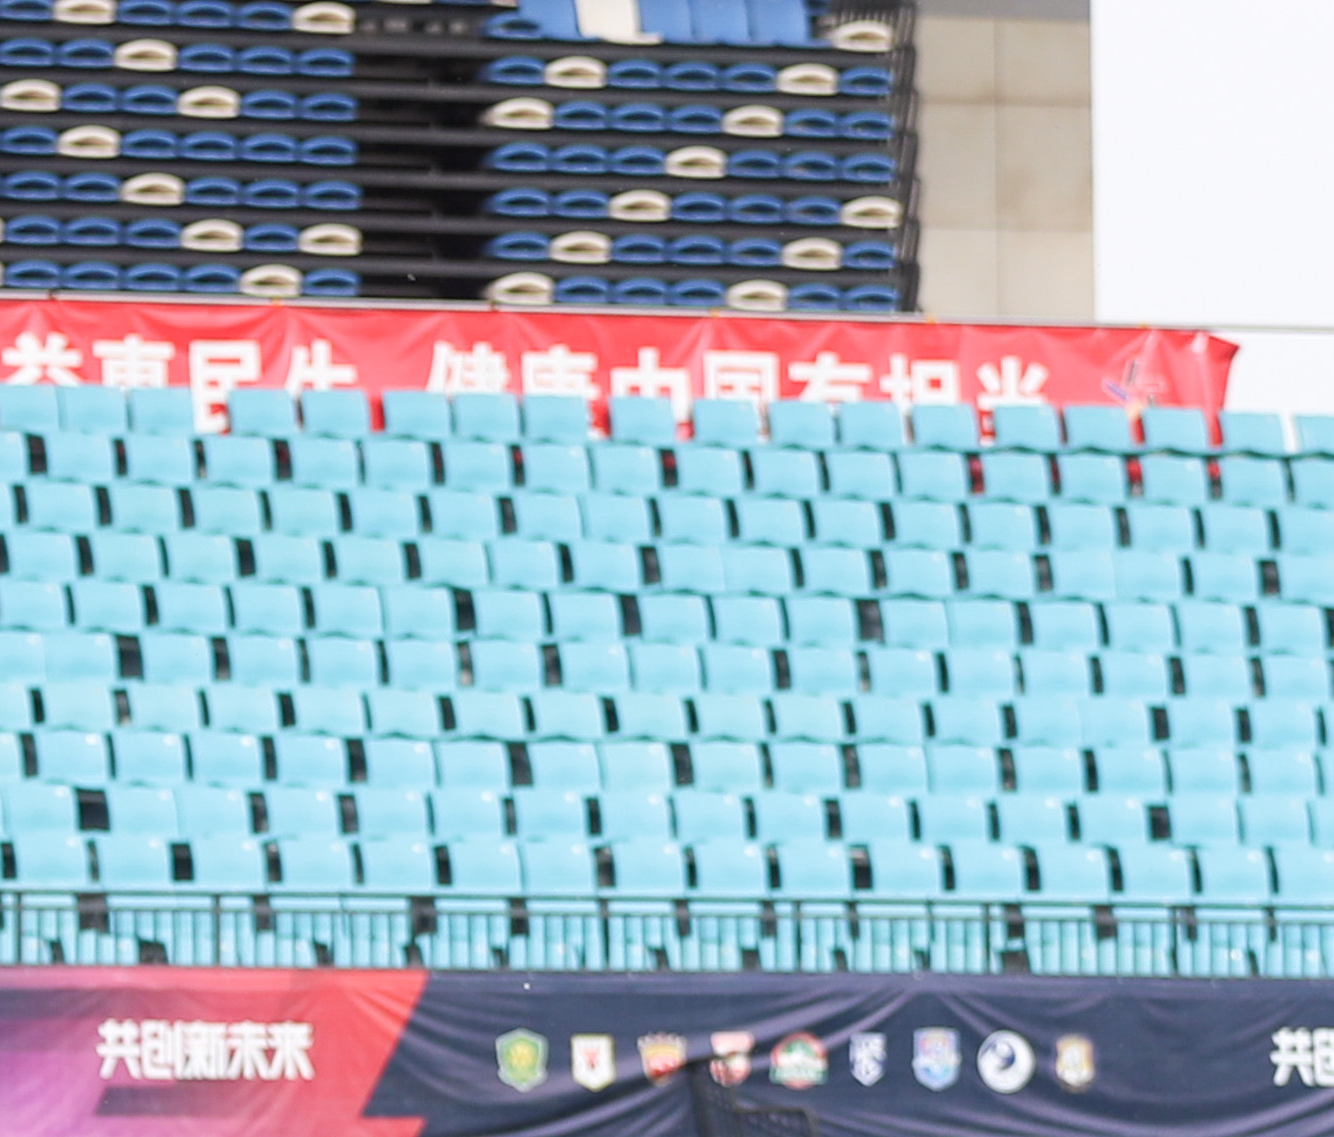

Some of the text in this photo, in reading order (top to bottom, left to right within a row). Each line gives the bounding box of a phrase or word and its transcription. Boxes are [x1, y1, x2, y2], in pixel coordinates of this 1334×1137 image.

[96, 1018, 315, 1081] 共创新未来
